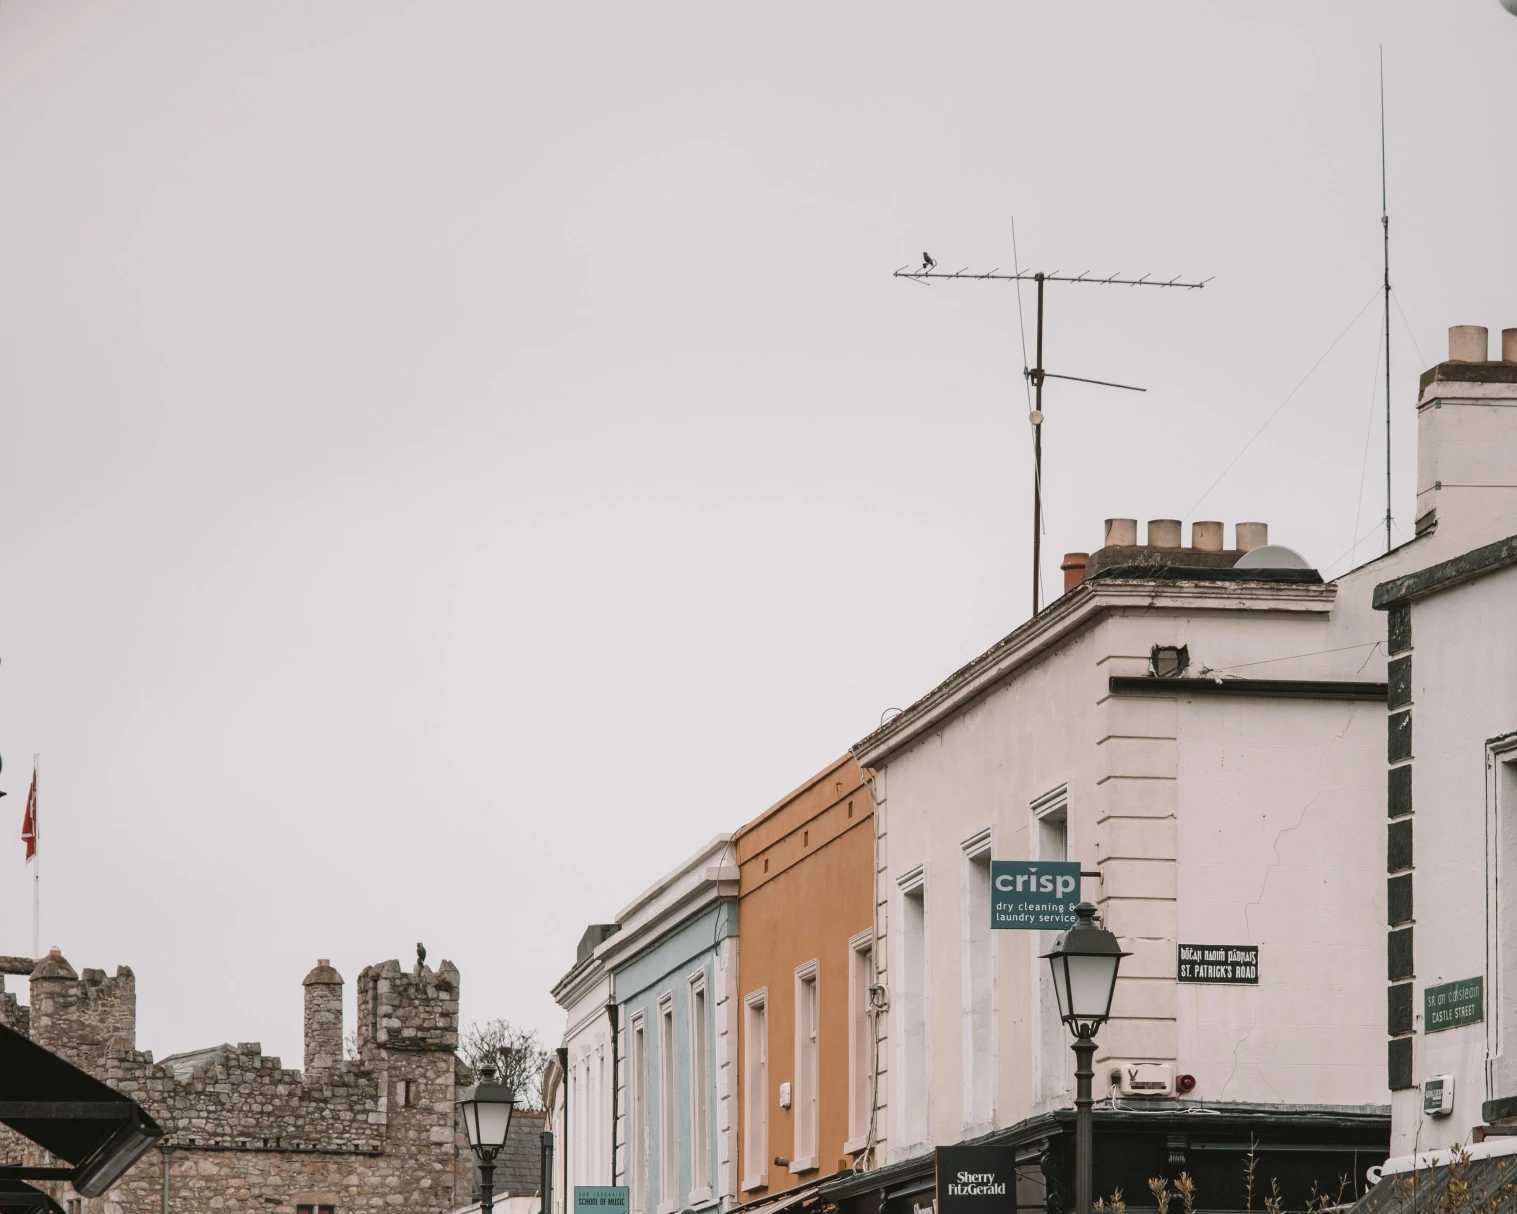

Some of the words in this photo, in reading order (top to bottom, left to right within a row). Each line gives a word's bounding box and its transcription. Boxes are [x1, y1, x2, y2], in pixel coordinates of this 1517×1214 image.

[995, 867, 1076, 899] crisp
[996, 902, 1014, 912] dry
[1018, 902, 1064, 913] cleaning
[996, 913, 1035, 923] laundry
[1181, 964, 1193, 977] ST.
[1194, 965, 1233, 978] PATRICK'S
[1235, 966, 1256, 979] ROAD
[1432, 1009, 1453, 1024] CASTLE
[1454, 1004, 1475, 1019] STREET
[957, 1171, 996, 1186] Sherry
[948, 1183, 1006, 1195] FitzGerald
[578, 1198, 599, 1206] SCHOOL
[599, 1198, 607, 1206] OF
[608, 1198, 625, 1206] MUSIC
